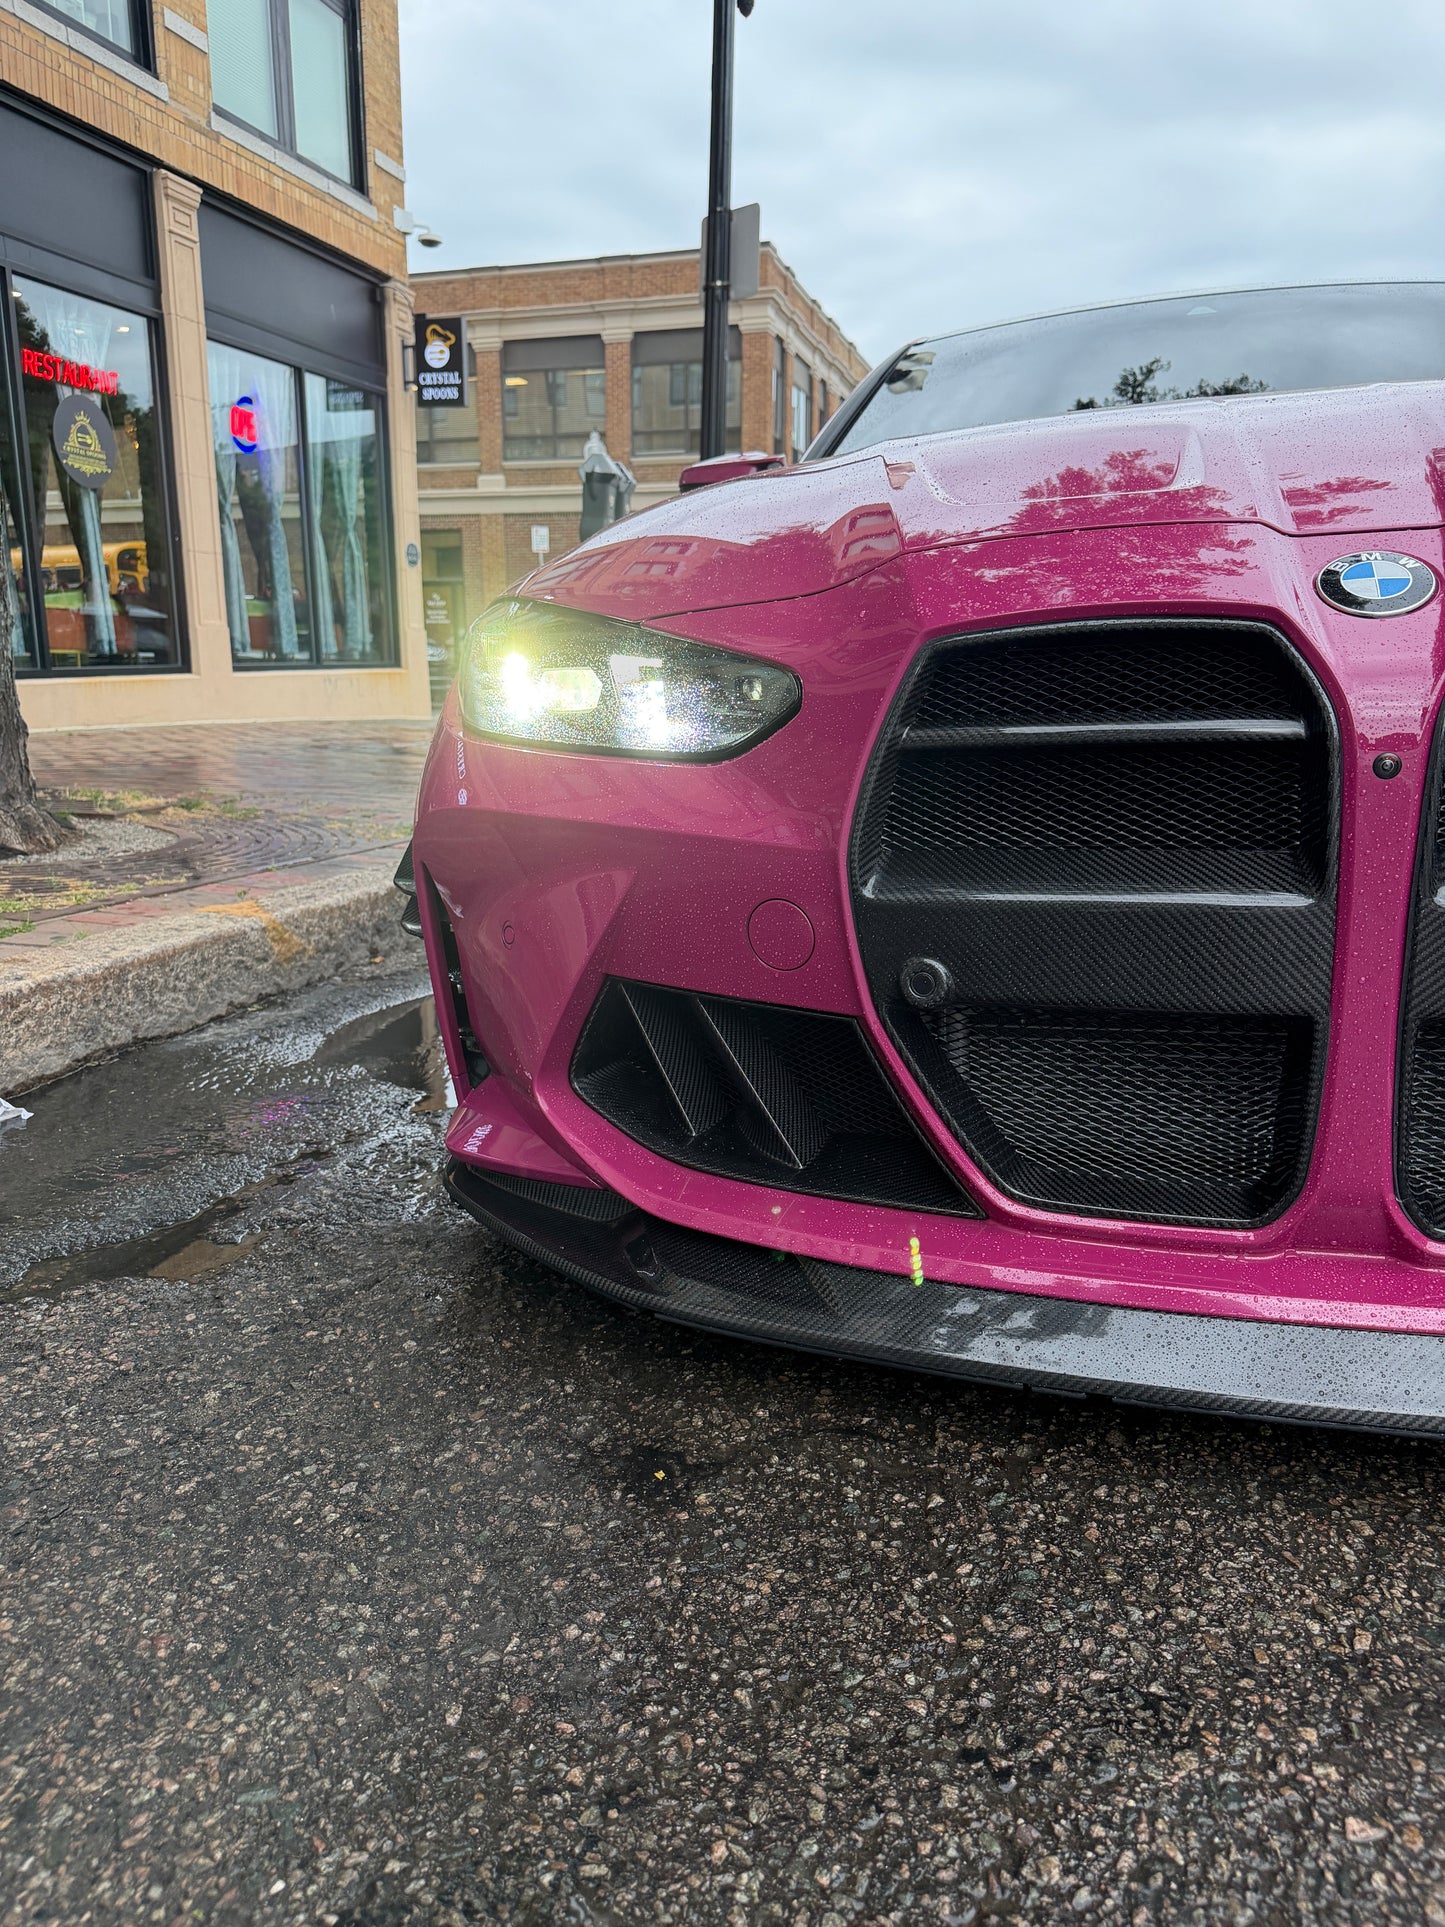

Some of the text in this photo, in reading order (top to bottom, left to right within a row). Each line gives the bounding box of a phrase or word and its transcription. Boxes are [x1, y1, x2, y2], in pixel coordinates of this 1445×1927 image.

[22, 348, 120, 396] RESTAURANT
[418, 371, 462, 385] CRYSTAL
[421, 386, 459, 401] SPOONS
[230, 405, 257, 443] OPE
[1328, 552, 1421, 572] BMW
